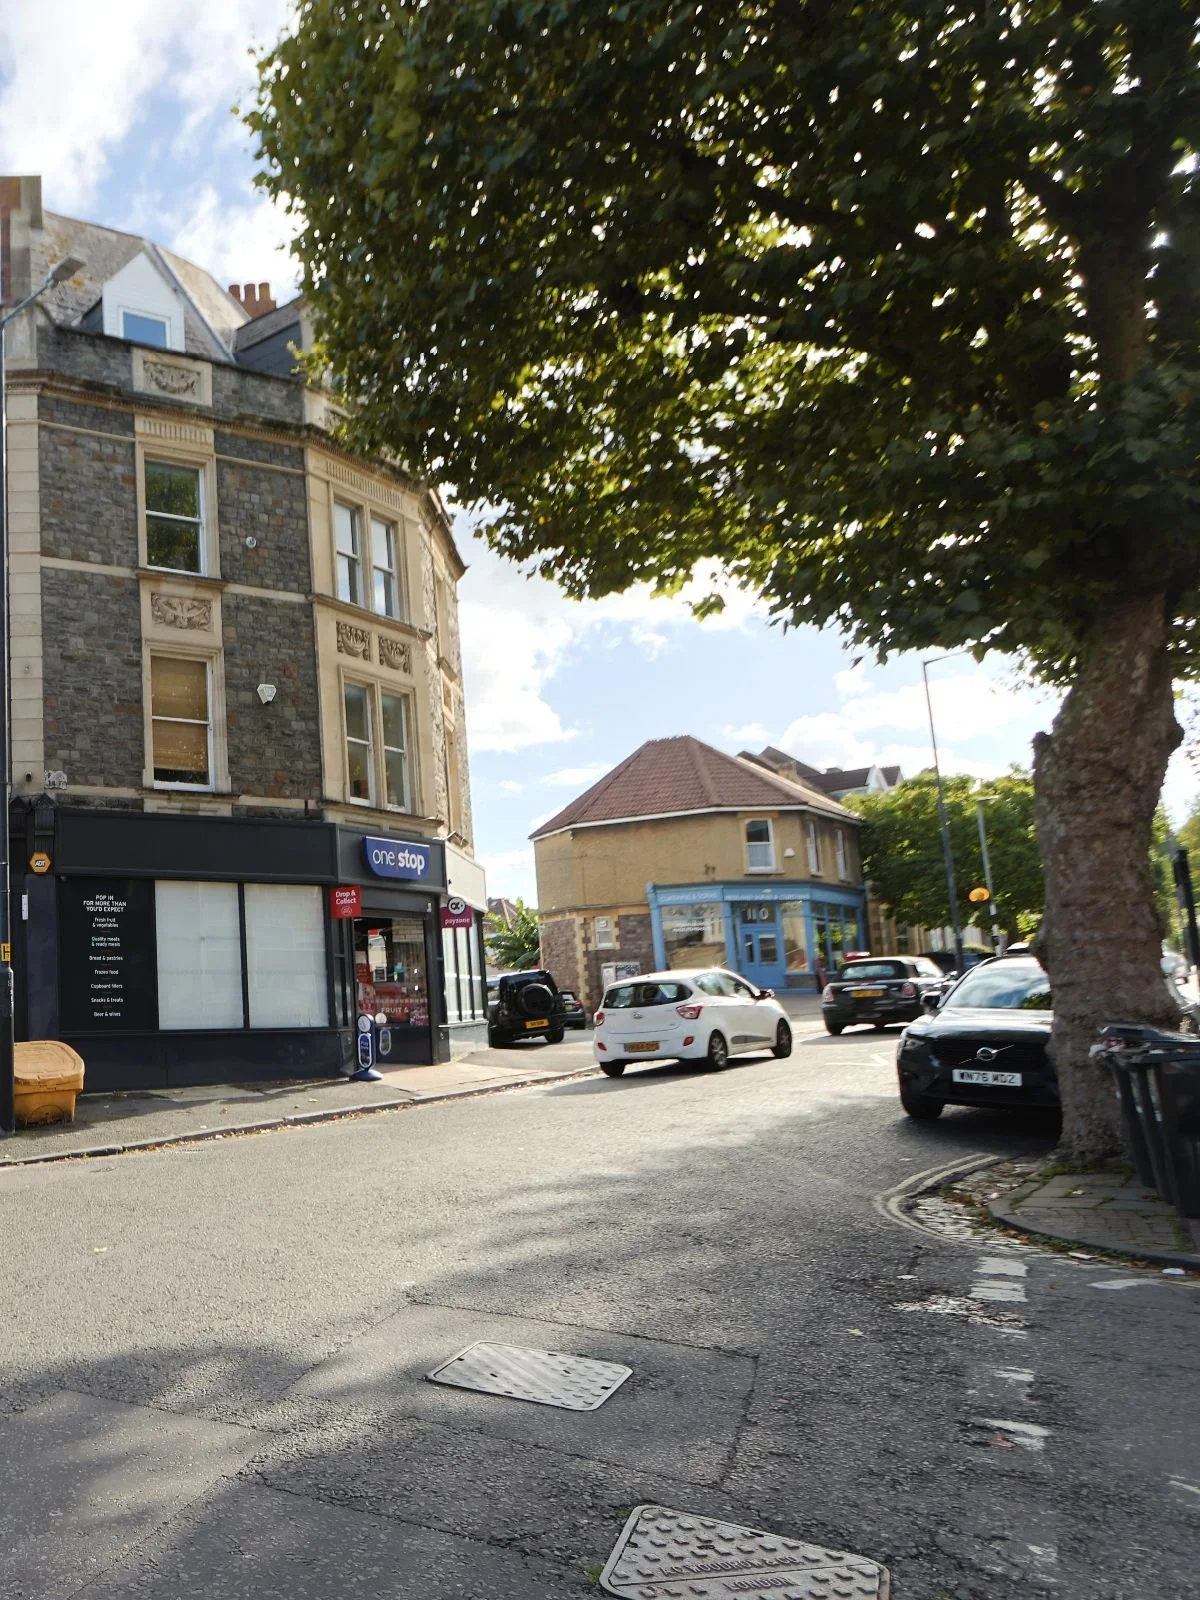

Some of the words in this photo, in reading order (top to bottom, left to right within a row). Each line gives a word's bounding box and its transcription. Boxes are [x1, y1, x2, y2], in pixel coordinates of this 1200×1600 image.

[372, 850, 396, 866] one
[398, 849, 425, 876] stop
[747, 908, 769, 920] 110
[722, 1576, 800, 1592] LONDON
